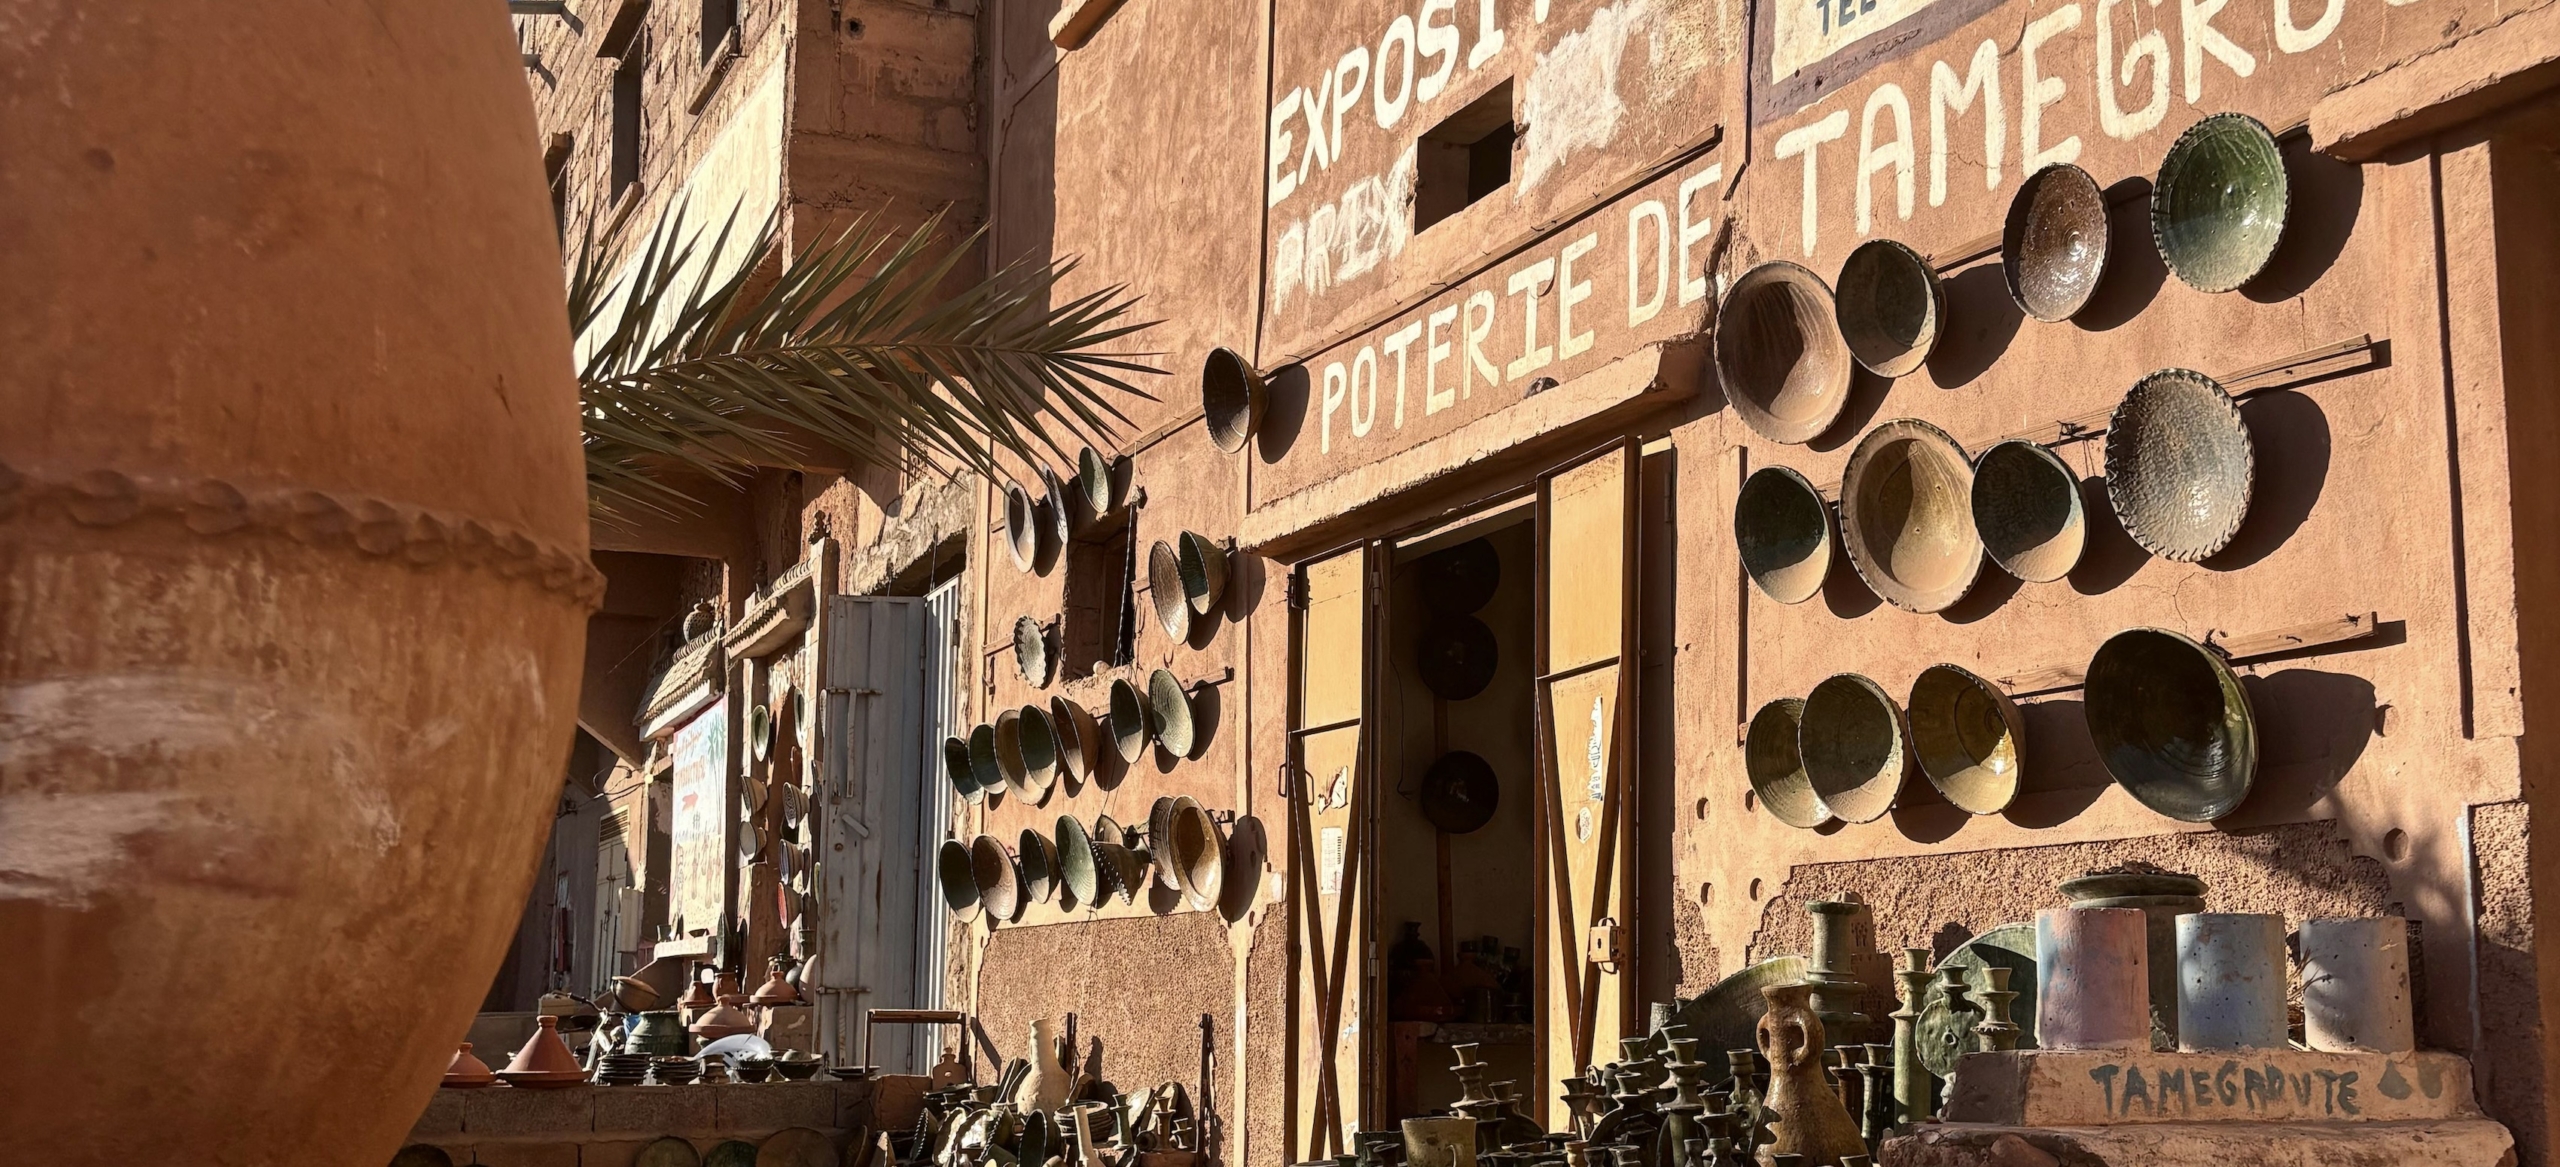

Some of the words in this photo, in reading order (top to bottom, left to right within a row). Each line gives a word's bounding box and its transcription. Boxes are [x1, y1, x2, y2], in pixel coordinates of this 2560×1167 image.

[1268, 0, 1551, 208] EXPOSI
[1321, 233, 1598, 455] POTERIE
[1628, 163, 1728, 328] DE
